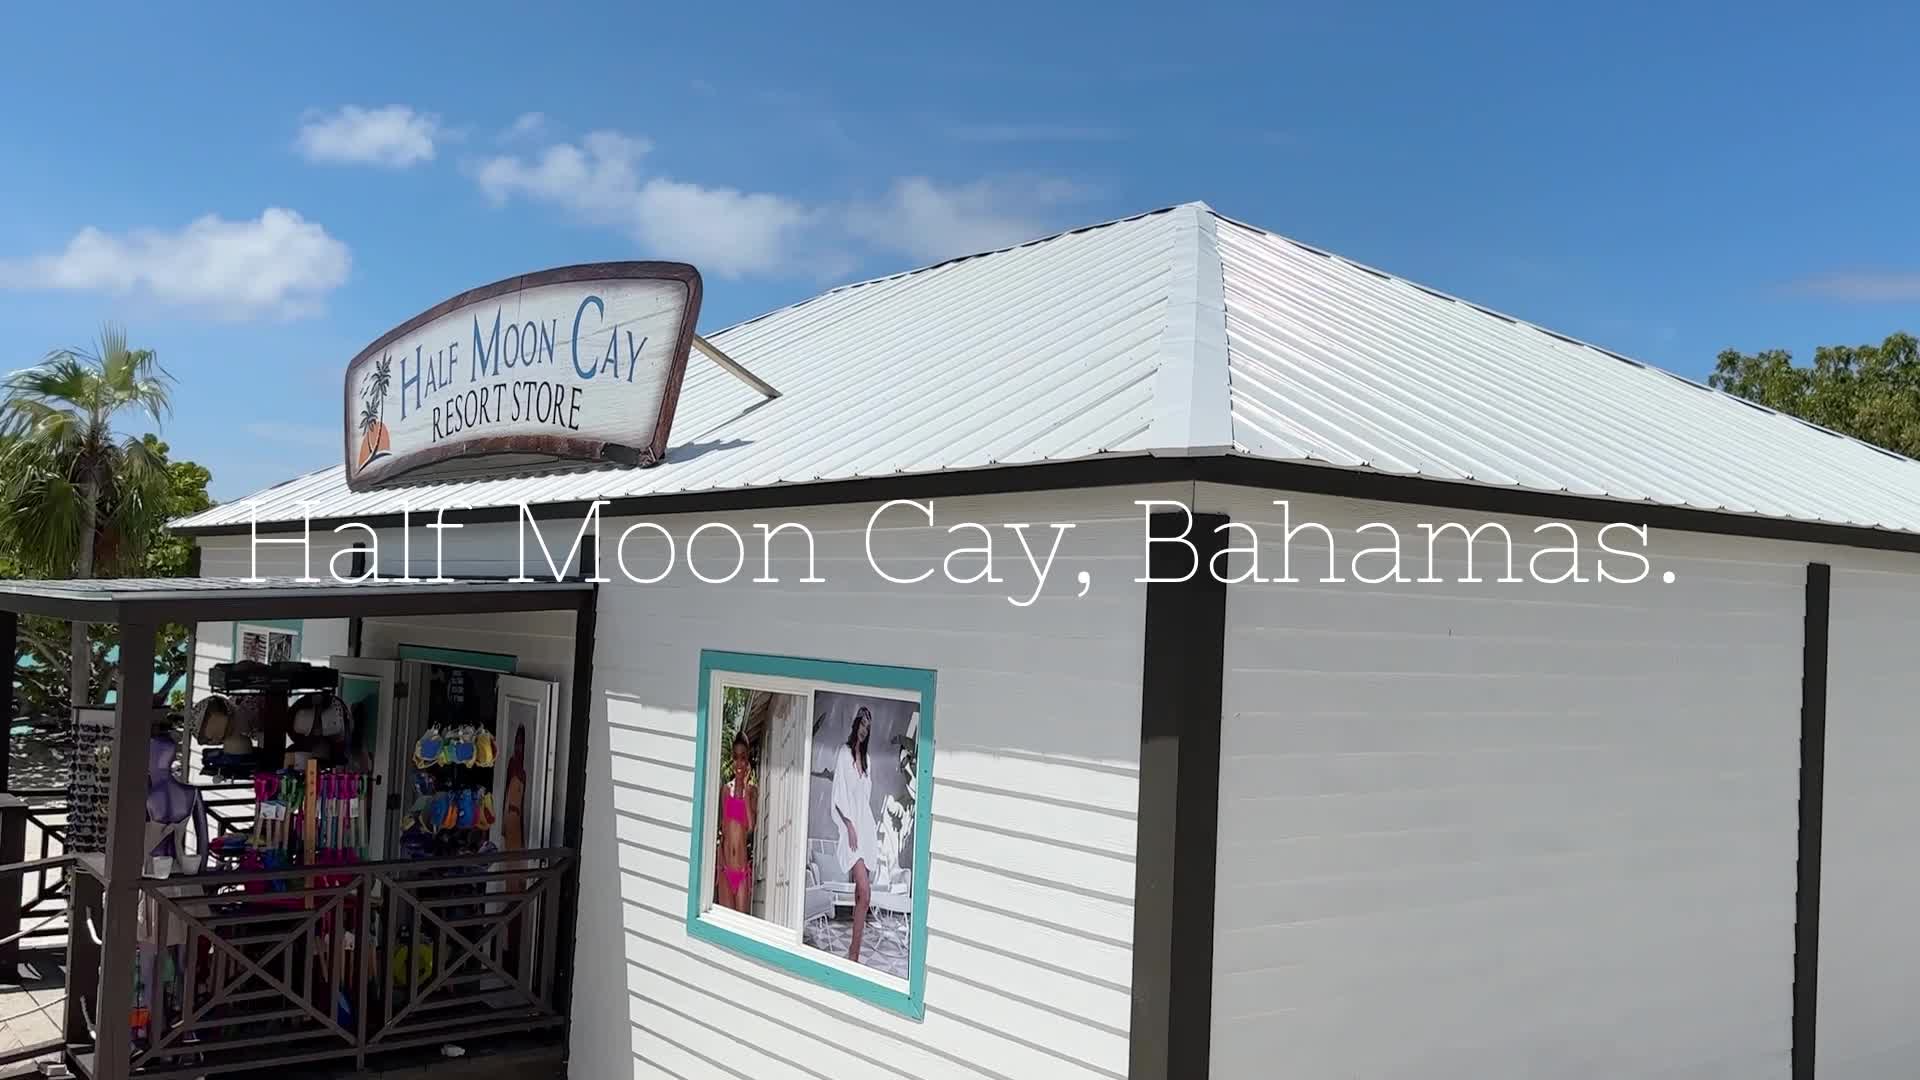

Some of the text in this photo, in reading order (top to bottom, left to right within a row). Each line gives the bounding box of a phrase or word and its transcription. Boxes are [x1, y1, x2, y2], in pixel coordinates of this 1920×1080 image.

[400, 295, 648, 421] HALF MOON CAY
[432, 381, 583, 443] RESORT STORE
